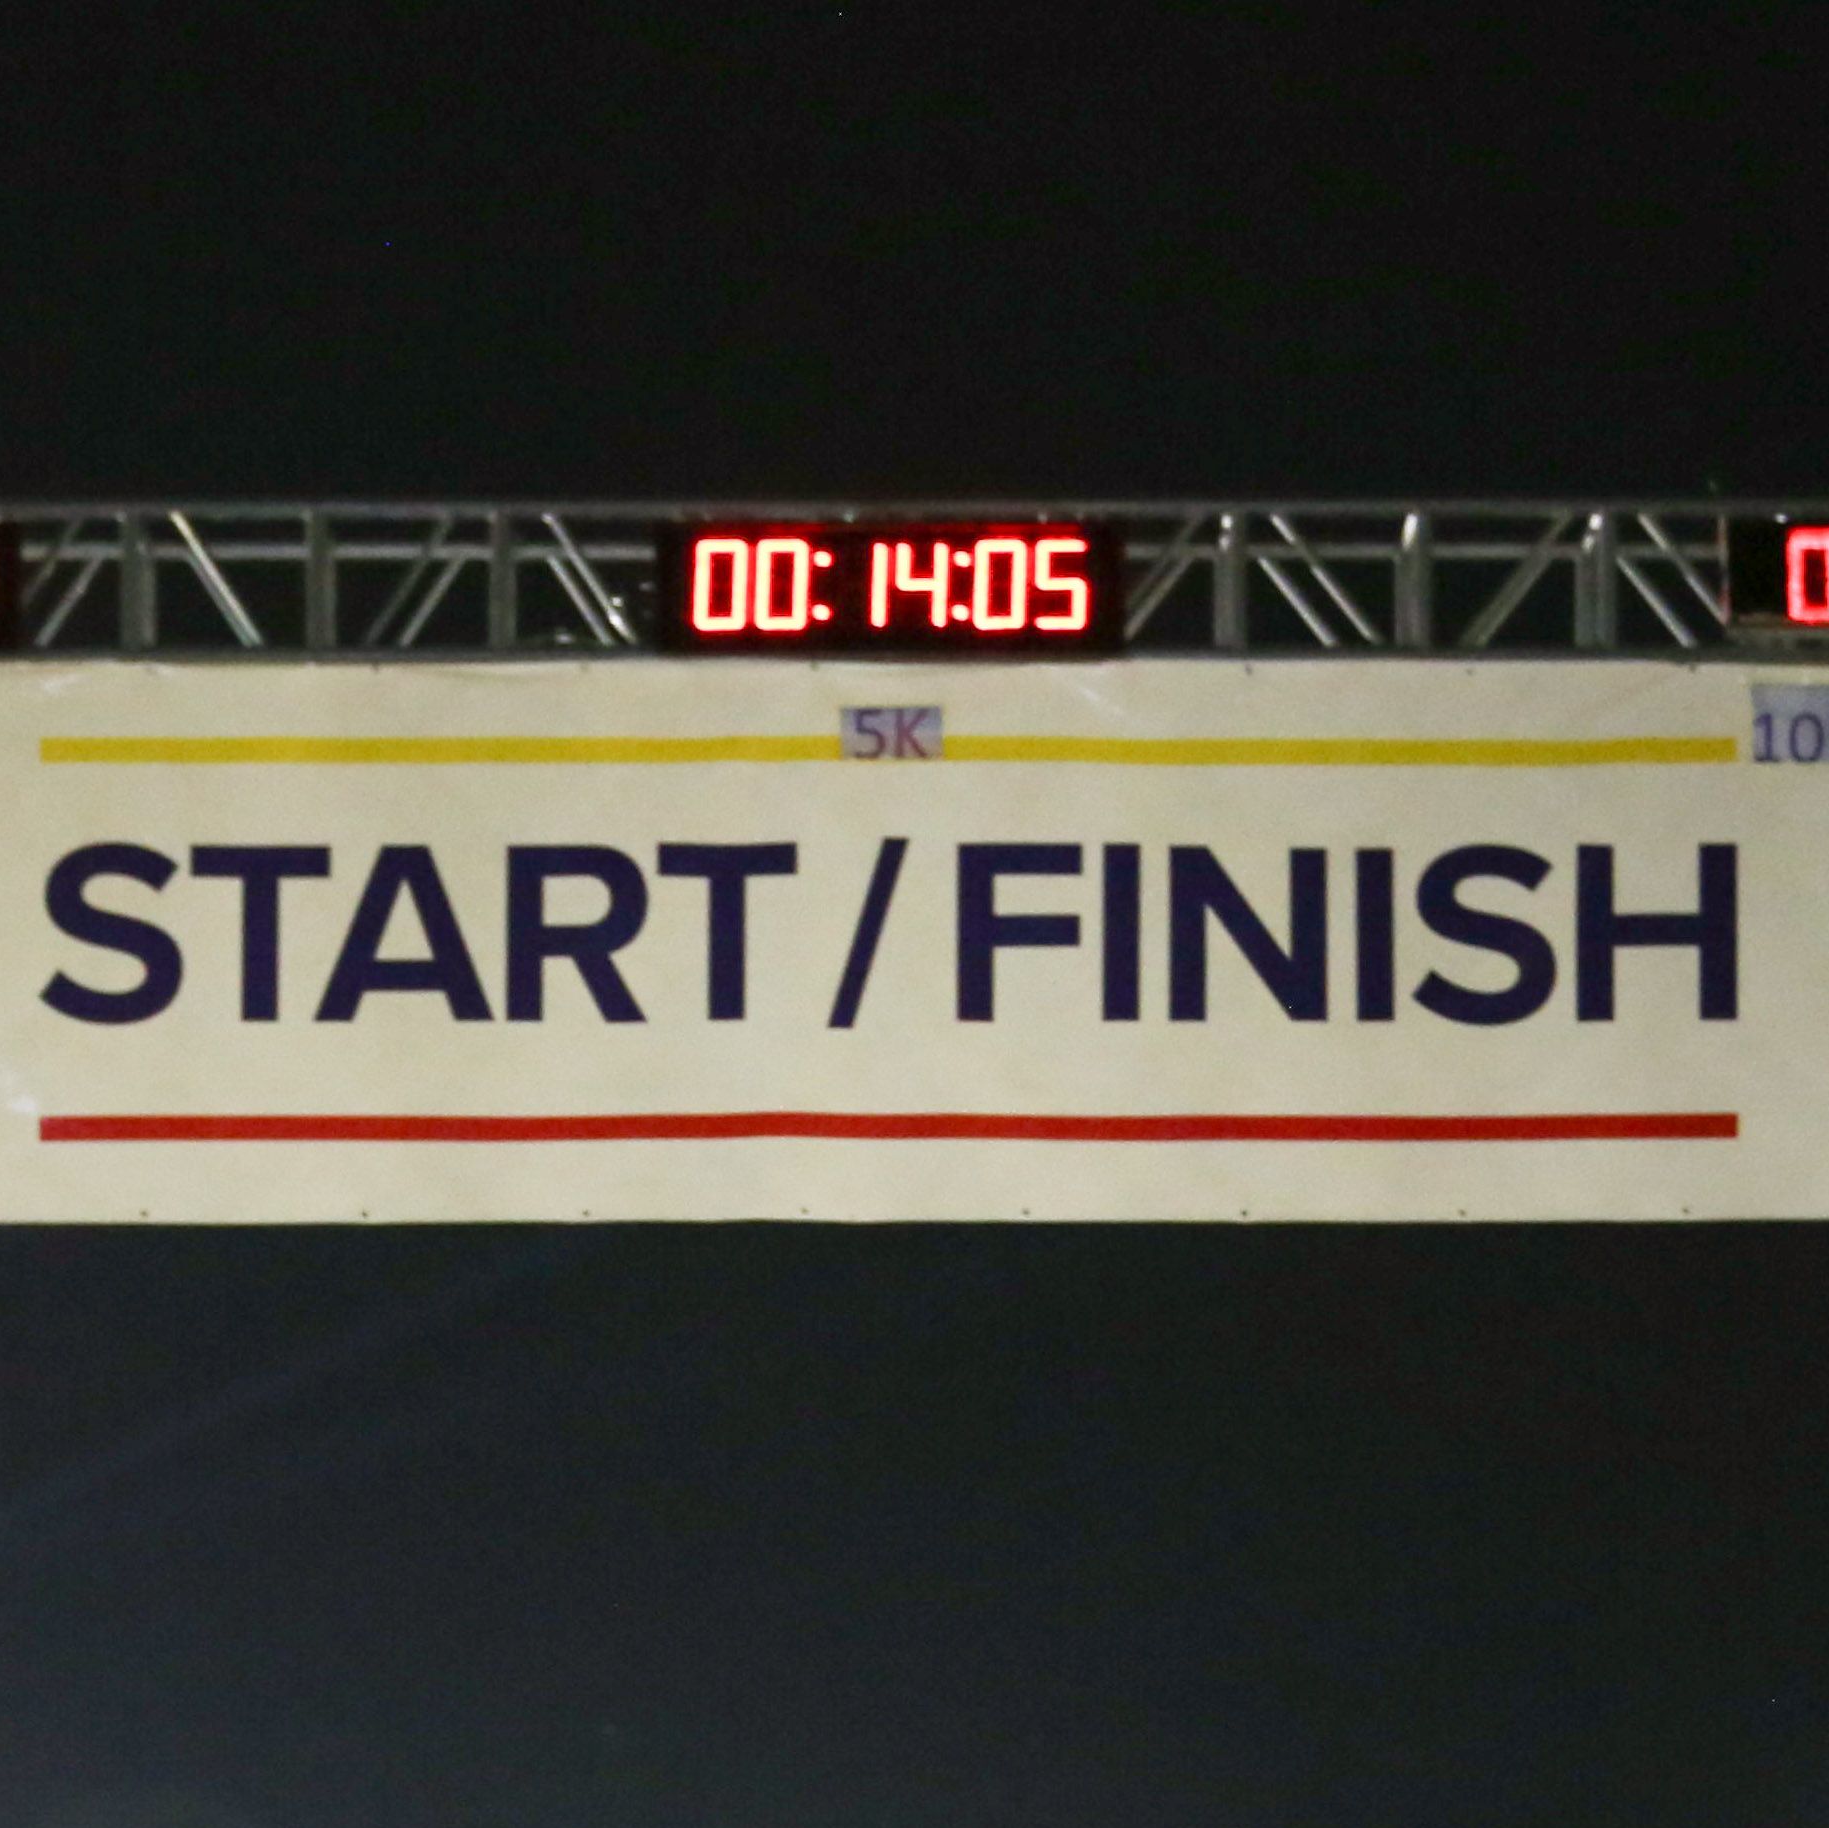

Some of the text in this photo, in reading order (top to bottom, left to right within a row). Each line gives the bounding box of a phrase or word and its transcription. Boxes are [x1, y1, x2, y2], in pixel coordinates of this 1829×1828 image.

[853, 707, 930, 760] 5K
[39, 840, 798, 1027] START
[956, 840, 1739, 1027] FINISH
